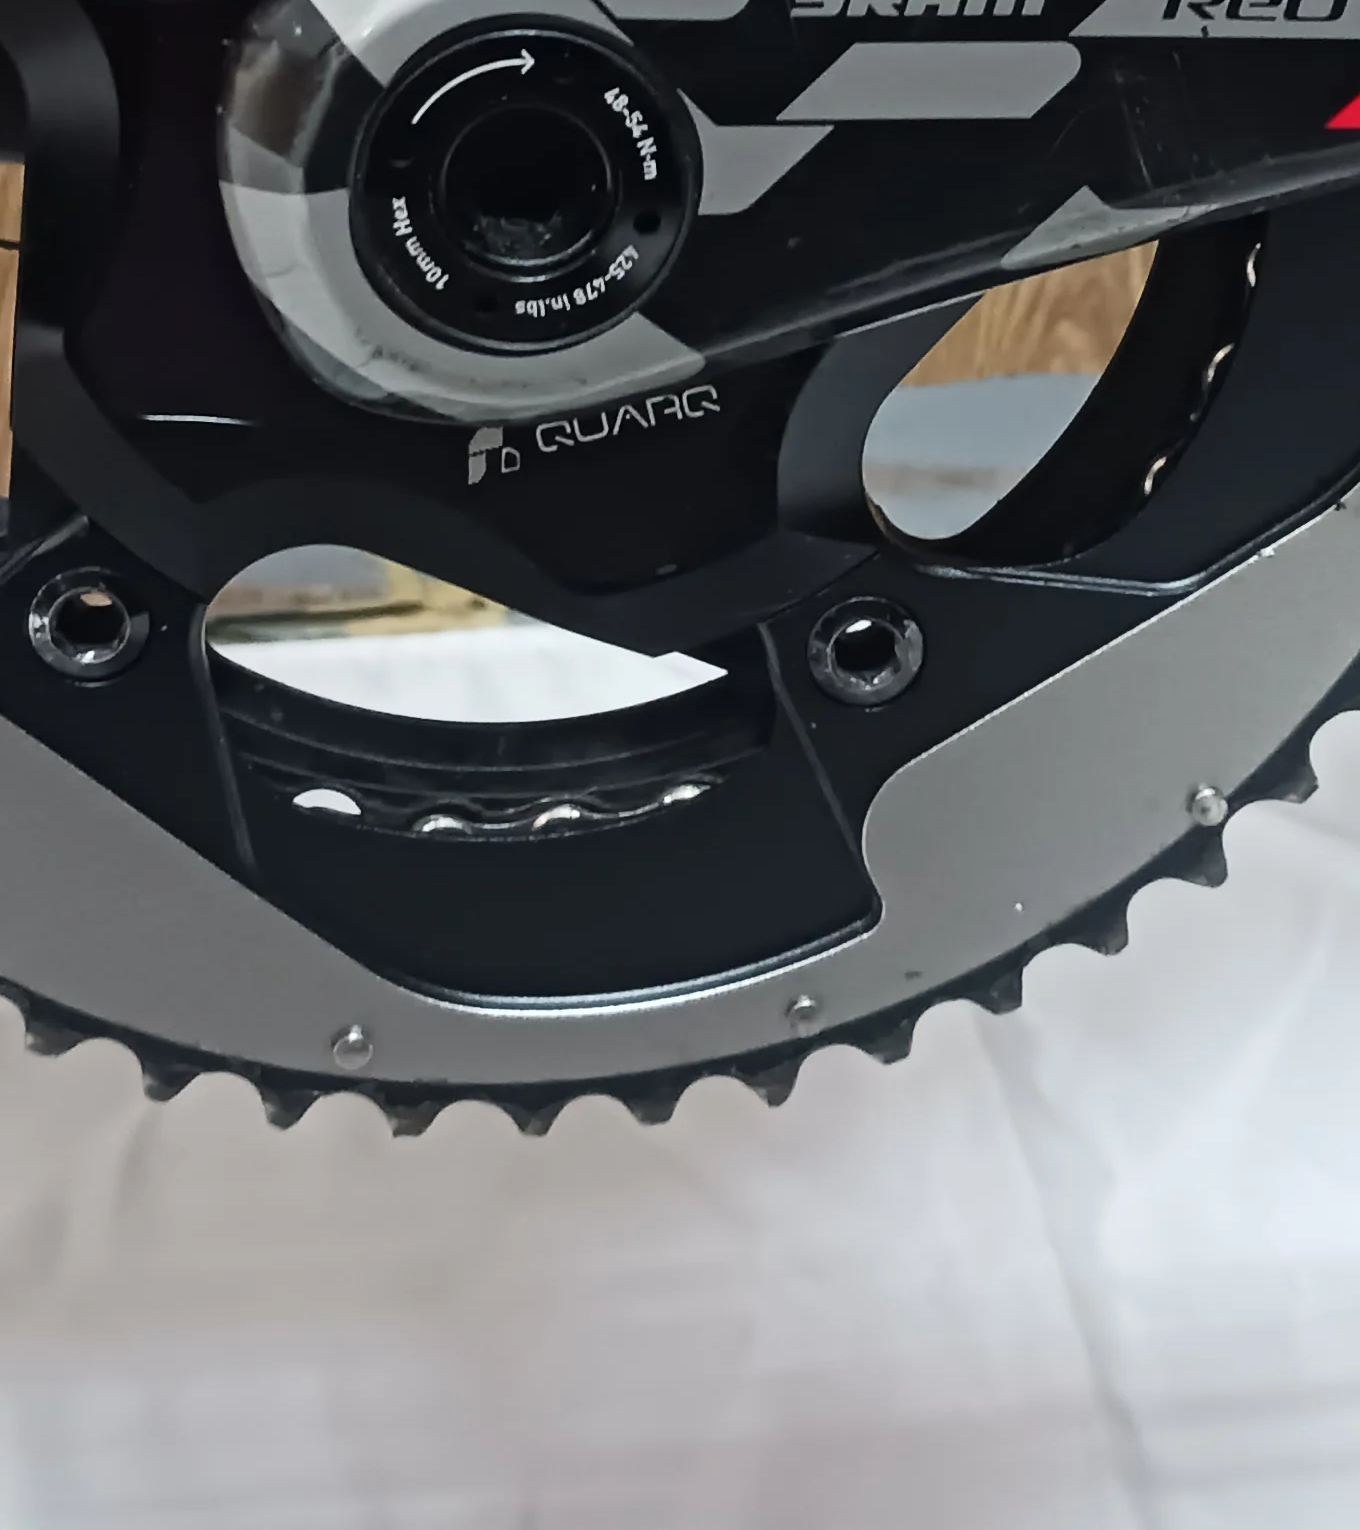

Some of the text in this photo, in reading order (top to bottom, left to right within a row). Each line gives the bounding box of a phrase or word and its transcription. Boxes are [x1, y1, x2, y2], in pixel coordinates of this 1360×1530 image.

[392, 196, 449, 290] 10mm Hex
[573, 244, 639, 306] 425-478
[535, 384, 721, 453] QUARQ
